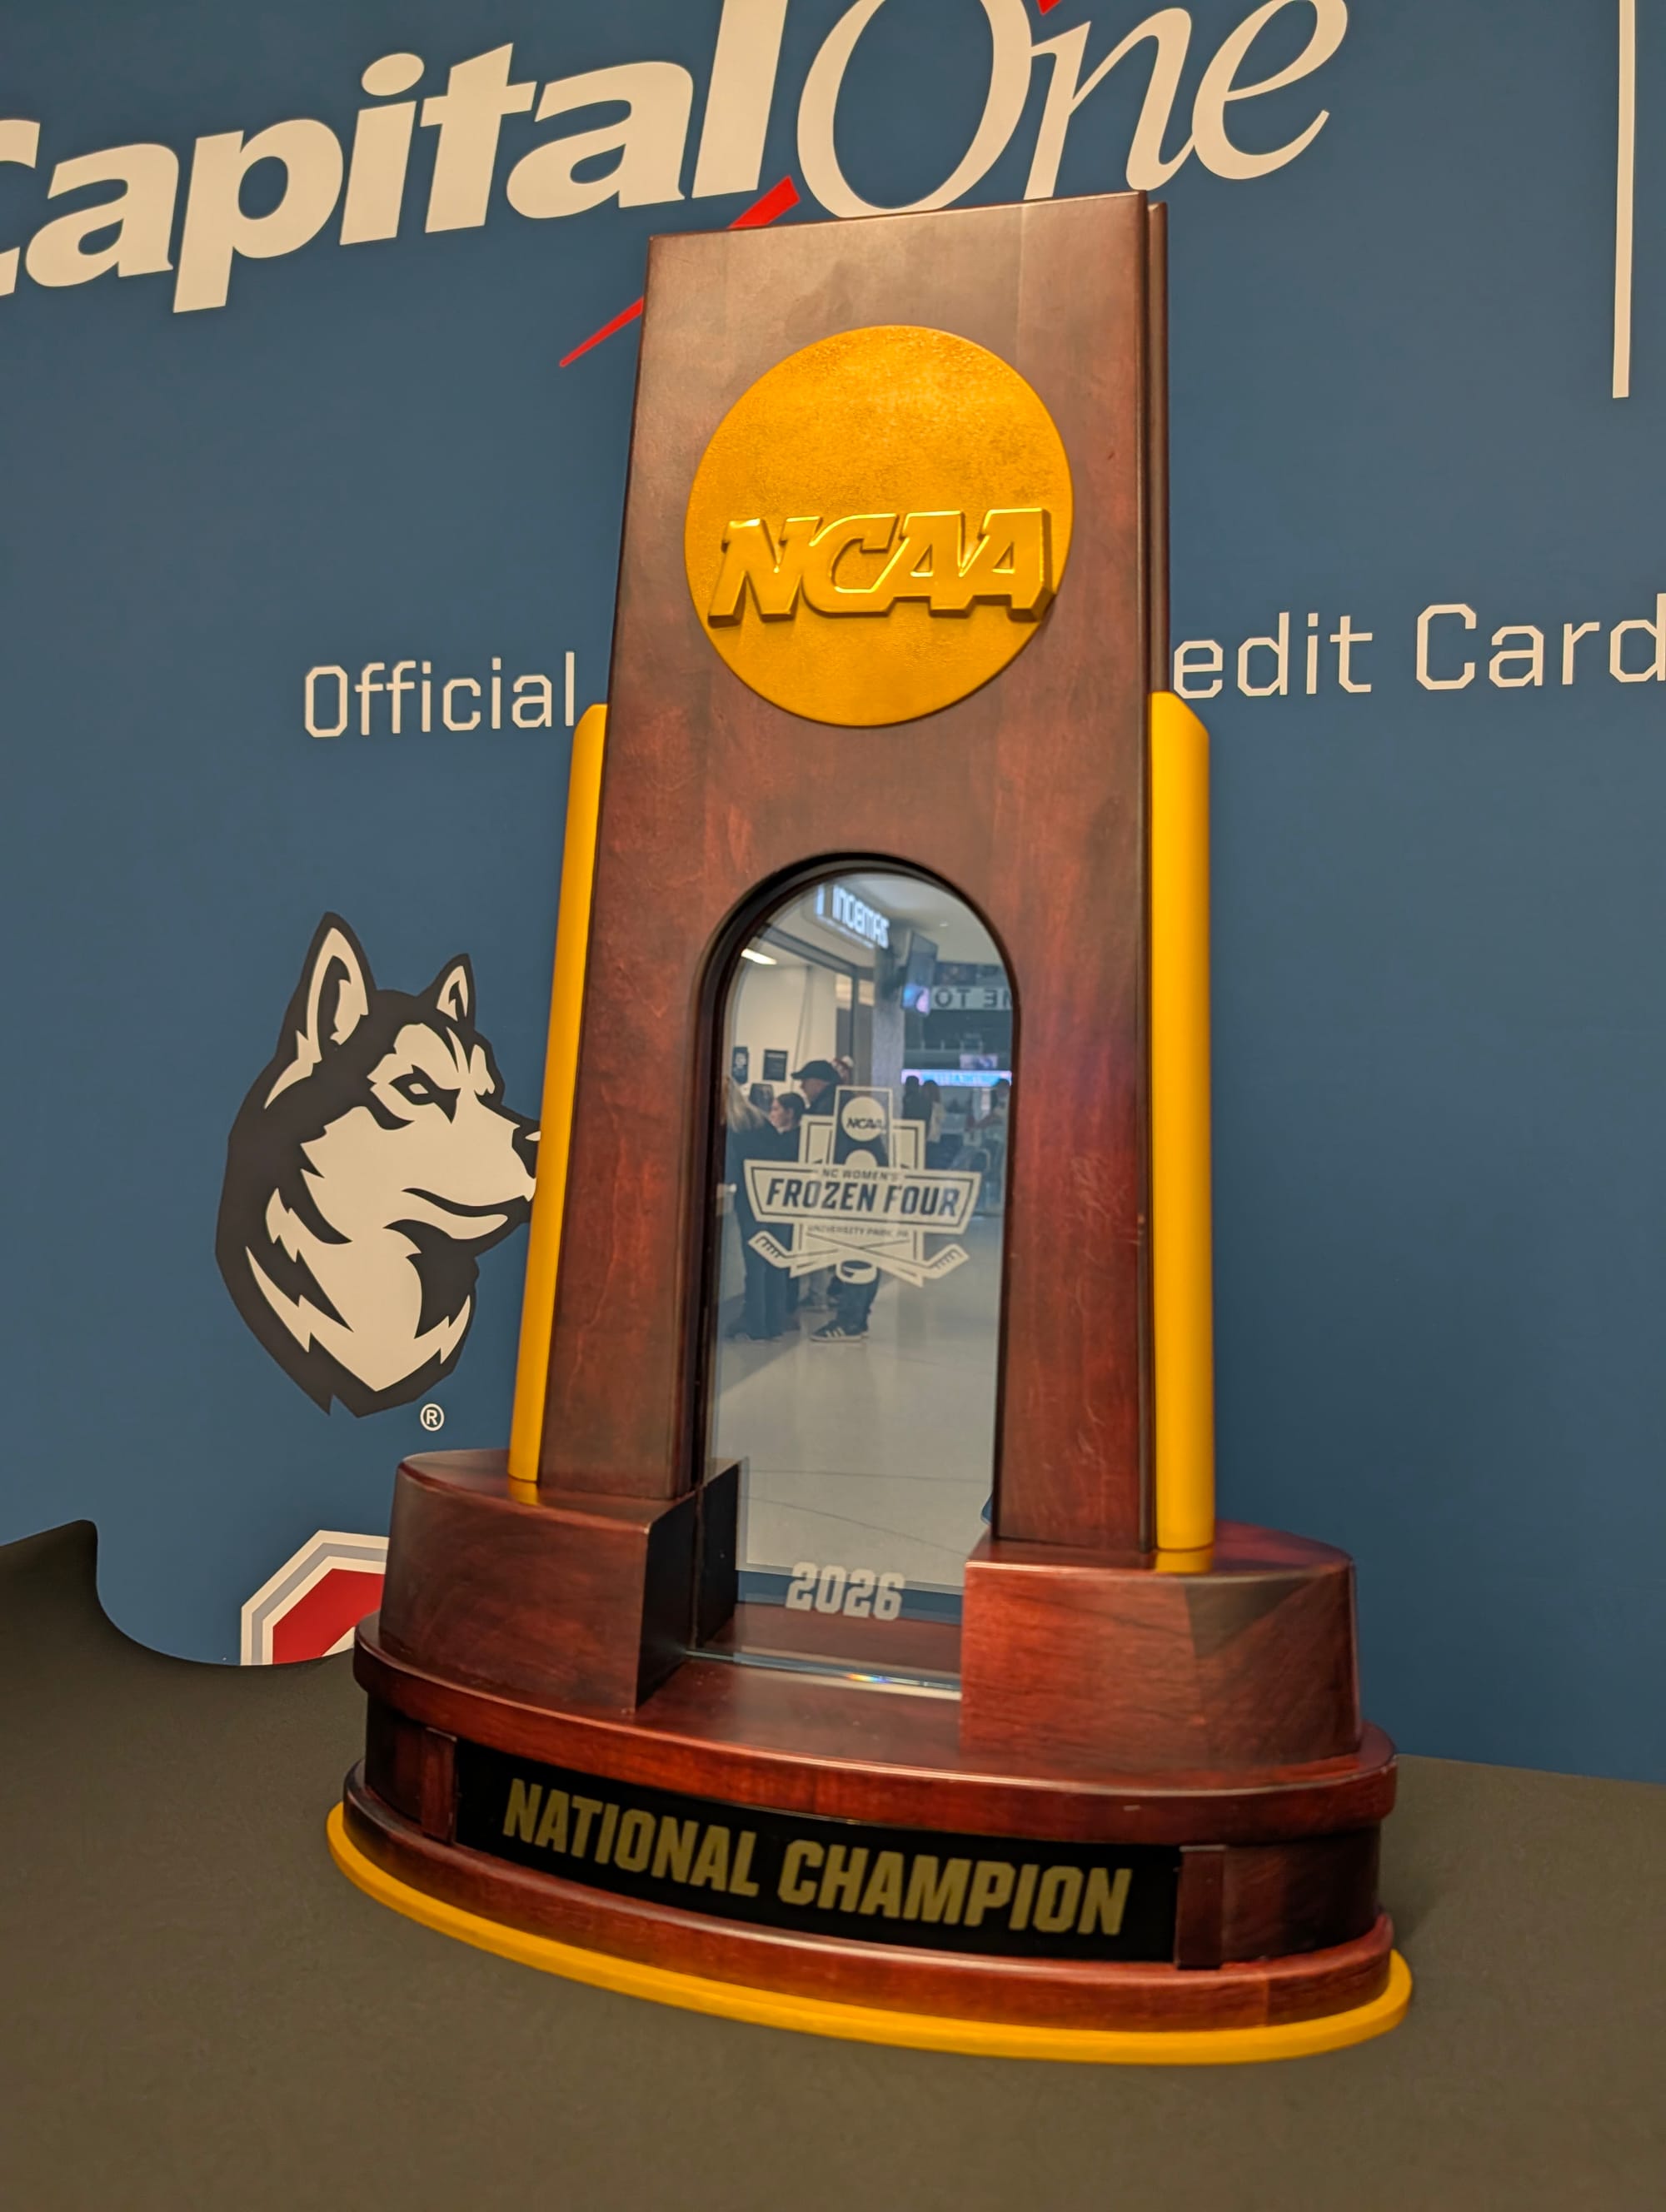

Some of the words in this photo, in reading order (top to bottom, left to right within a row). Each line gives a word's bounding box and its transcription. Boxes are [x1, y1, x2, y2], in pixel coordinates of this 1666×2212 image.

[708, 507, 1056, 628] NCAA
[305, 651, 574, 738] Official
[1173, 611, 1373, 700] edit
[1416, 593, 1666, 690] Card
[766, 1178, 878, 1213] FROZEN
[883, 1183, 960, 1218] FOUR
[786, 1562, 905, 1621] 2026
[503, 1777, 759, 1898] NATIONAL
[777, 1840, 1132, 1936] CHAMPION
